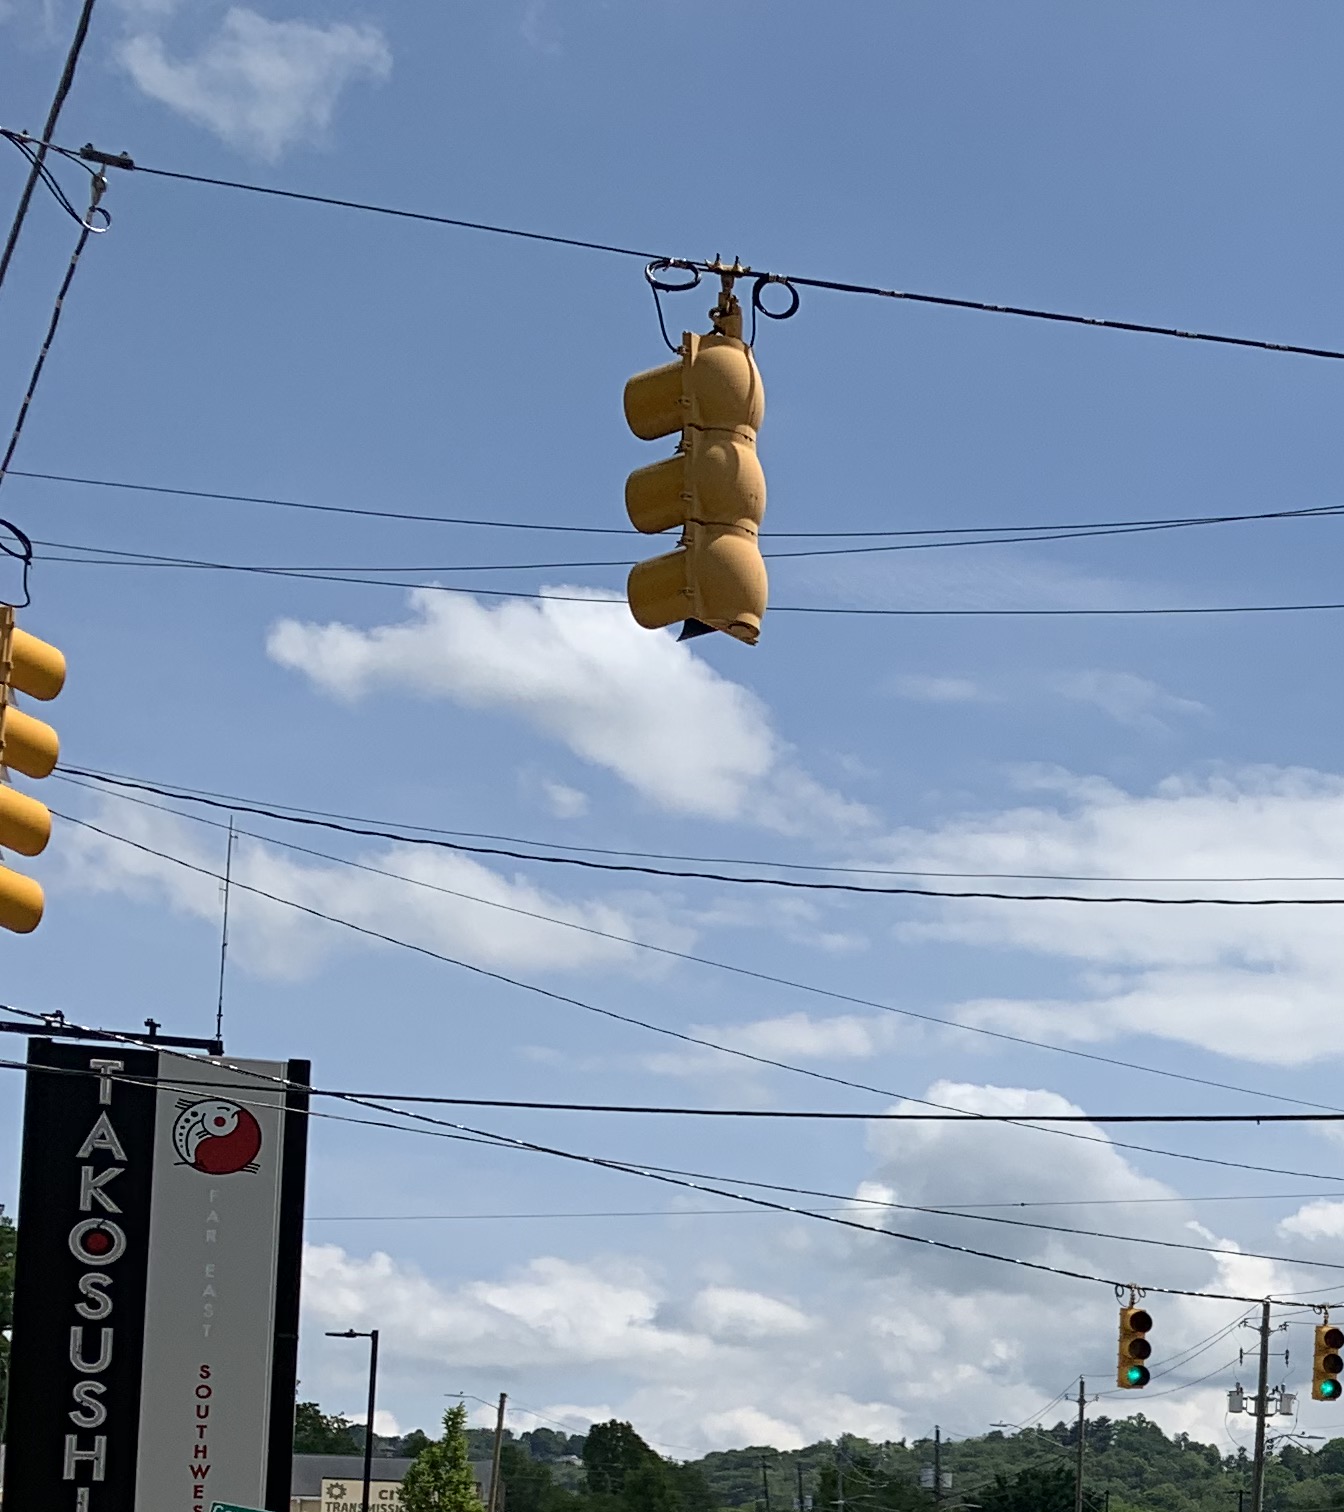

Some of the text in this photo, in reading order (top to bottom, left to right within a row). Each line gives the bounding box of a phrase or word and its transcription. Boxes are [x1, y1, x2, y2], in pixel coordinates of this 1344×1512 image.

[202, 1189, 219, 1338] FAR EAST
[378, 1489, 395, 1500] CI
